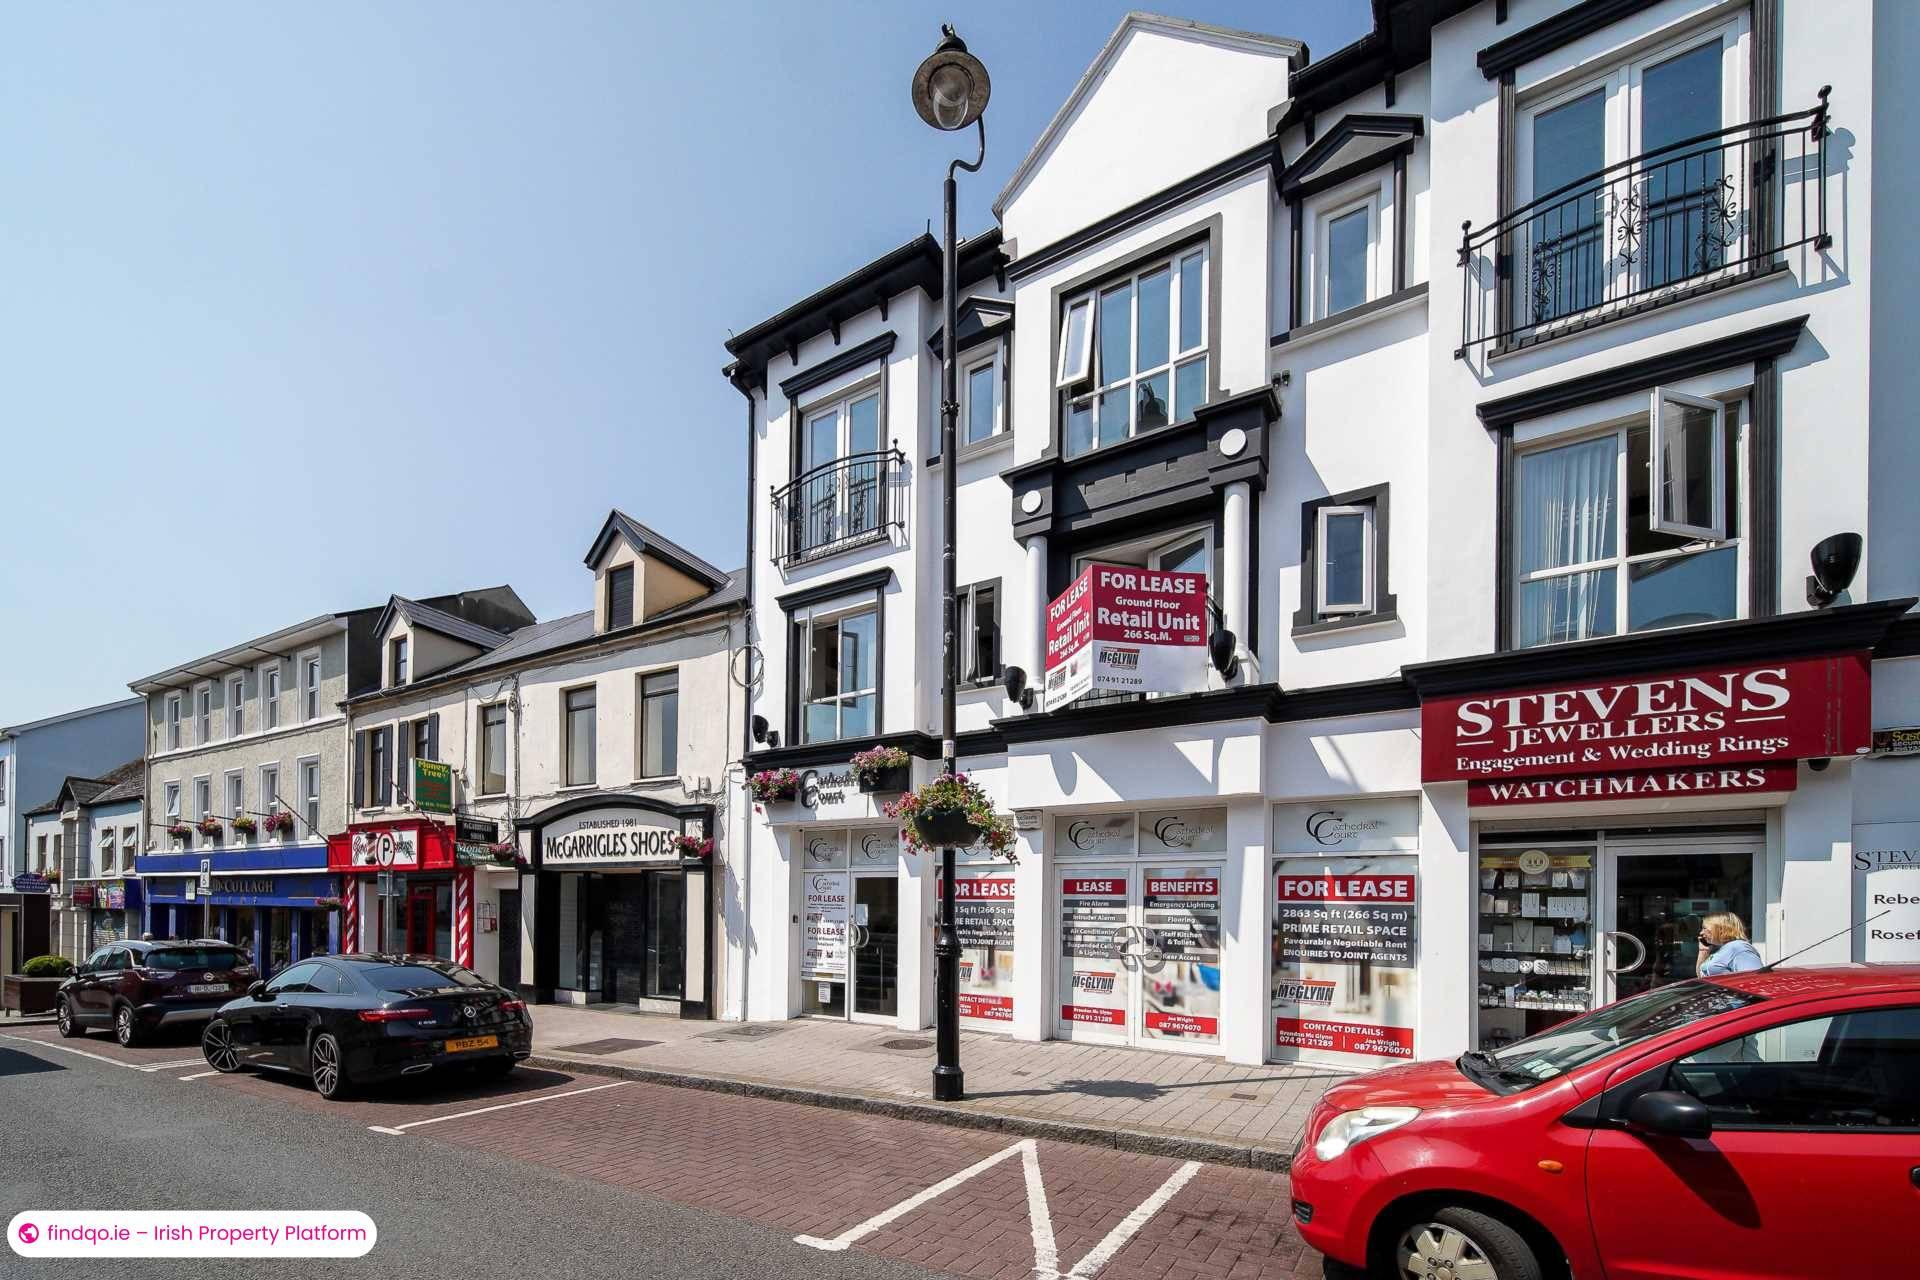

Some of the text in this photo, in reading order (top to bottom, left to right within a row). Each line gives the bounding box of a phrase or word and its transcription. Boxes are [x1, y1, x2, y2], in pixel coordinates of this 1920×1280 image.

[1100, 571, 1196, 594] FOR LEASE
[1050, 575, 1088, 623] FOR LEASE
[1115, 596, 1180, 609] Ground Floor
[1097, 607, 1200, 631] Retail Unit
[1048, 611, 1089, 656] Retail Unit
[1124, 629, 1142, 639] 266
[1143, 631, 1172, 642] Sq.M.
[1099, 651, 1139, 665] McGLYNN
[1121, 677, 1143, 685] 21289
[1456, 667, 1791, 738] STEVENS
[1502, 711, 1726, 753] JEWELLERS
[1456, 735, 1790, 774] Engagement & Wedding Rings
[1488, 768, 1767, 801] WATCHMAKERS
[579, 818, 637, 829] ESTABLISHED 1981
[382, 838, 390, 861] P
[546, 830, 675, 859] McGARRIGLES SHOES
[1076, 882, 1113, 892] LEASE
[1151, 881, 1214, 893] BENEFITS
[1284, 880, 1408, 898] FOR LEASE
[808, 894, 845, 903] FOR LEASE
[960, 905, 969, 914] Sq
[1186, 902, 1215, 910] Lighting
[966, 917, 991, 926] RETAIL
[1282, 909, 1408, 922] 2863 Sq ft (266 Sq m)
[807, 927, 845, 936] FOR LEASE
[1282, 923, 1407, 936] PRIME RETAIL SPACE
[1284, 937, 1407, 949] Favourable Negotiable Rent
[1283, 948, 1408, 961] ENQUIRIES TO JOINT AGENTS
[1071, 975, 1115, 990] McGLYNN
[1277, 984, 1335, 1001] McGLYNN
[1172, 1023, 1202, 1031] 9676070
[1303, 1022, 1384, 1036] CONTACT DETAILS:
[1279, 1035, 1295, 1043] 074
[1307, 1037, 1334, 1047] 21289
[1280, 1030, 1305, 1038] Brendan
[1315, 1032, 1333, 1041] Glynn
[1354, 1043, 1411, 1055] 087 9676070
[1377, 1039, 1400, 1047] Wright
